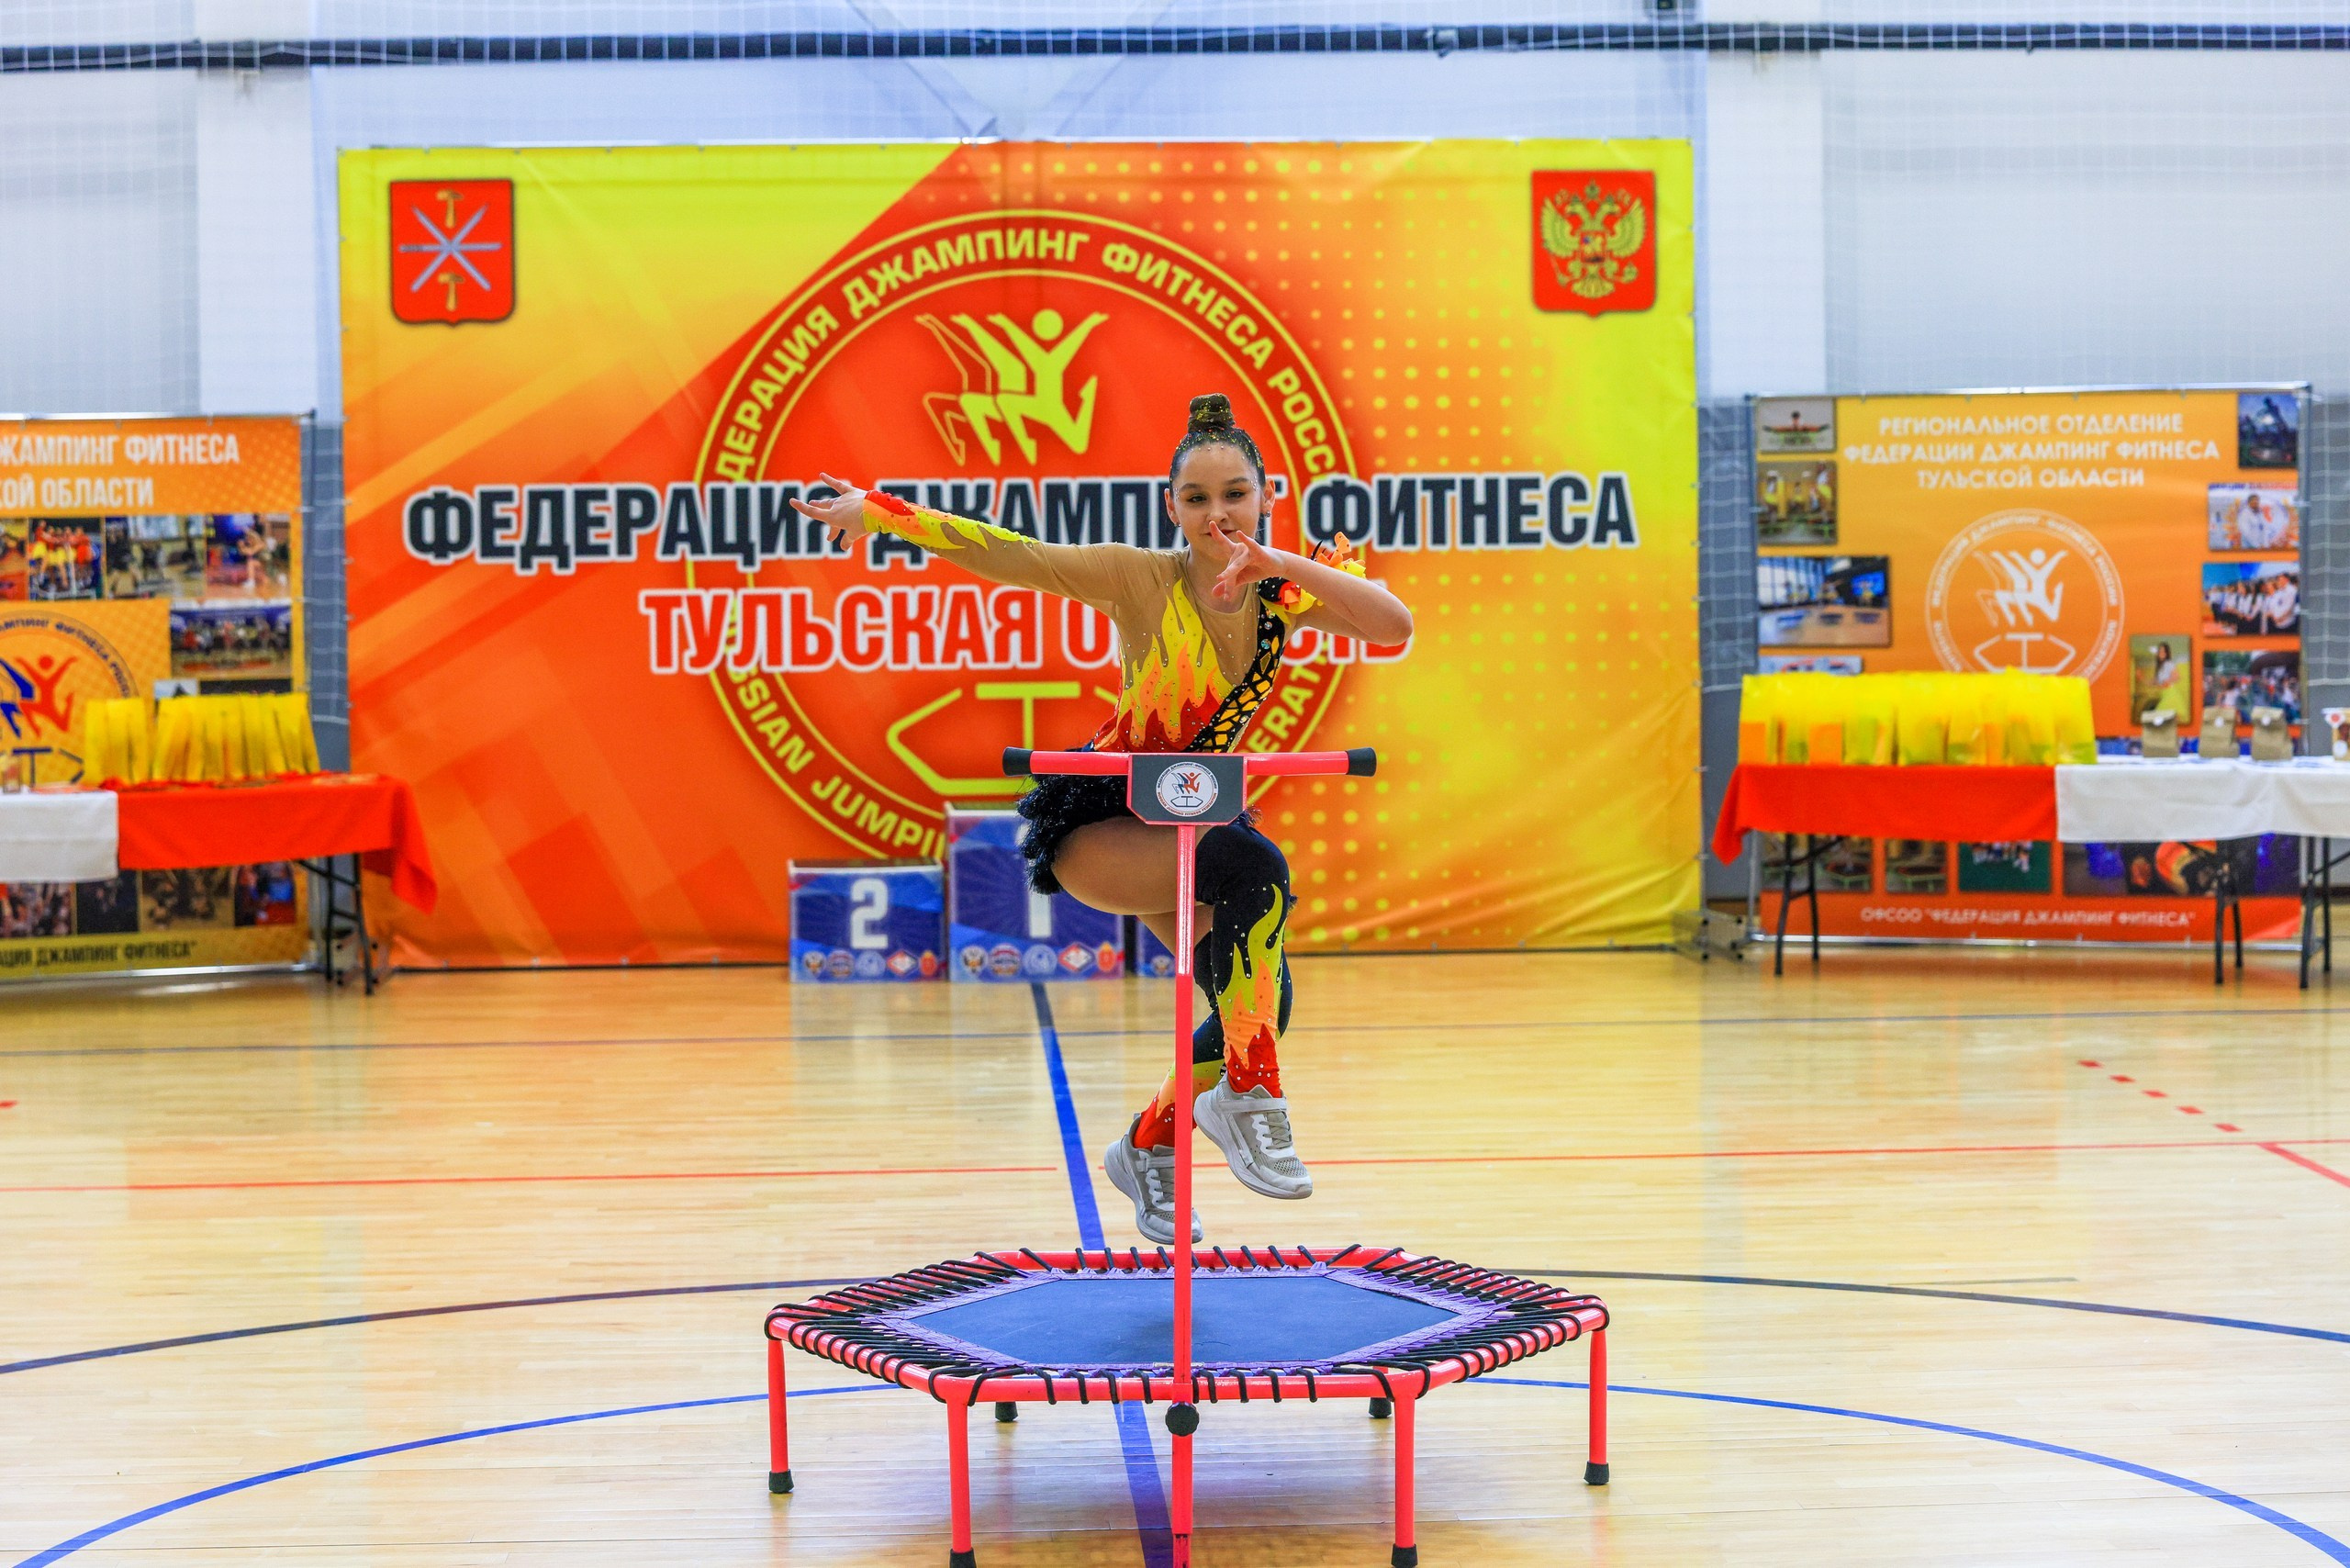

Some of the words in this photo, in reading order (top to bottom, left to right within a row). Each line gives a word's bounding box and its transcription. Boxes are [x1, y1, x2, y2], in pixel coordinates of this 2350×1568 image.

[714, 304, 840, 484] ДЕРАЦИЯ
[840, 228, 1091, 320] ДЖАМПИНГ
[1101, 241, 1276, 370] ФИТНЕСА
[1266, 365, 1337, 485] РОСС
[0, 434, 119, 465] ЖАМПИНГ
[124, 432, 241, 465] ФИТНЕСА
[1879, 414, 2050, 436] РЕГИОНАЛЬНОЕ
[2056, 412, 2184, 435] ОТДЕЛЕНИЕ
[1843, 443, 1973, 465] ФЕДЕРАЦИИ
[1979, 441, 2111, 463] ДЖАМПИНГ
[2116, 439, 2221, 461] ФИТНЕСА
[1917, 464, 2033, 489] ТУЛЬСКОЙ
[2038, 466, 2145, 488] ОБЛАСТИ
[40, 476, 155, 509] ОБЛАСТИ
[1303, 471, 1641, 553] ФИТНЕСА
[639, 585, 1044, 675] ТУЛЬСКАЯ
[811, 775, 946, 859] JUMPI
[849, 878, 889, 949] 2
